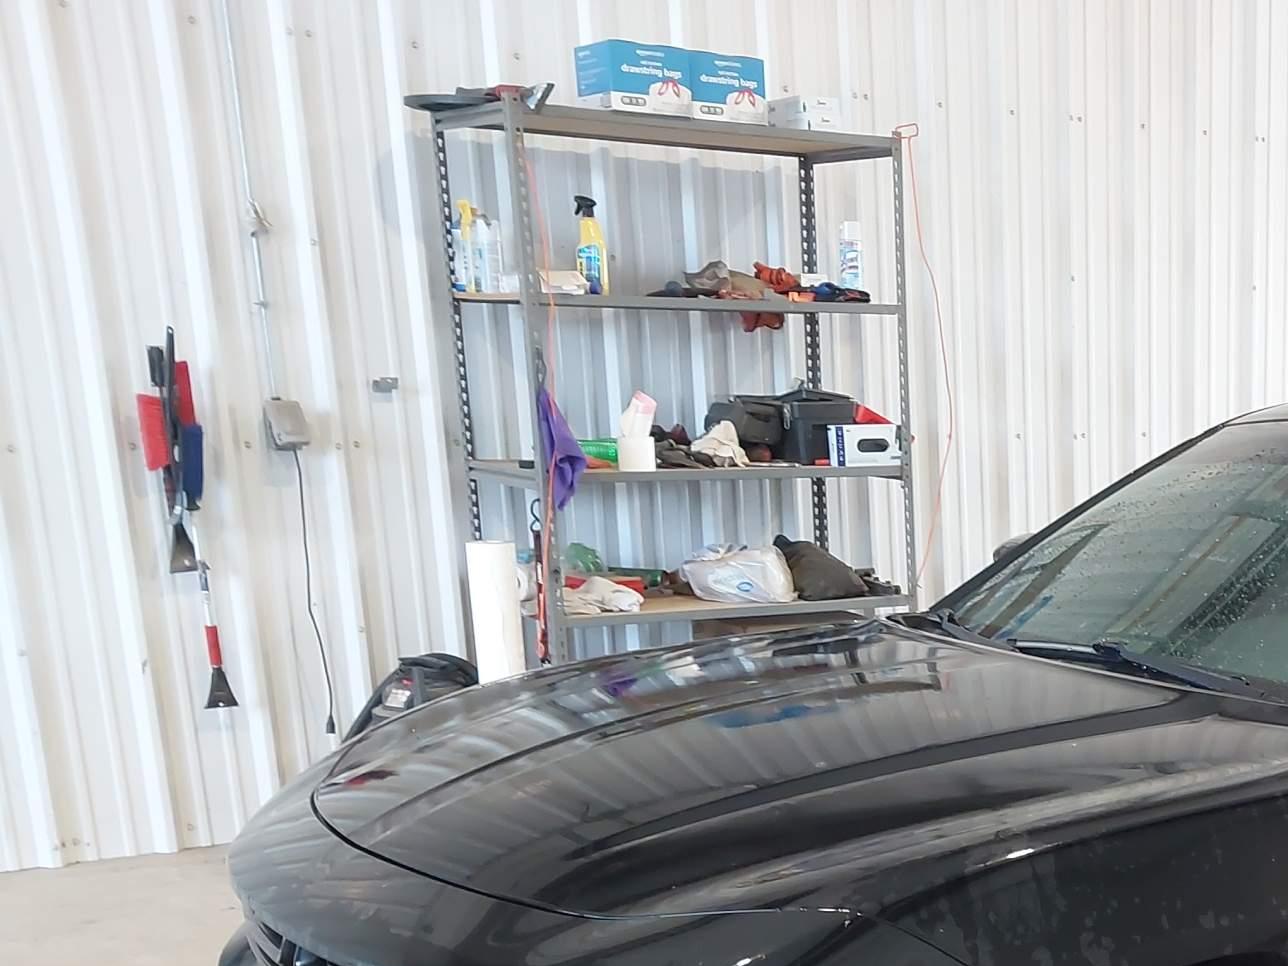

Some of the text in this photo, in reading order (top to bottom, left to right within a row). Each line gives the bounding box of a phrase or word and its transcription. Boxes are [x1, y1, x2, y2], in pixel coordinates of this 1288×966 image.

[620, 63, 663, 78] drawstring
[663, 68, 682, 80] bags
[700, 73, 739, 88] drawstring
[740, 78, 758, 89] bags
